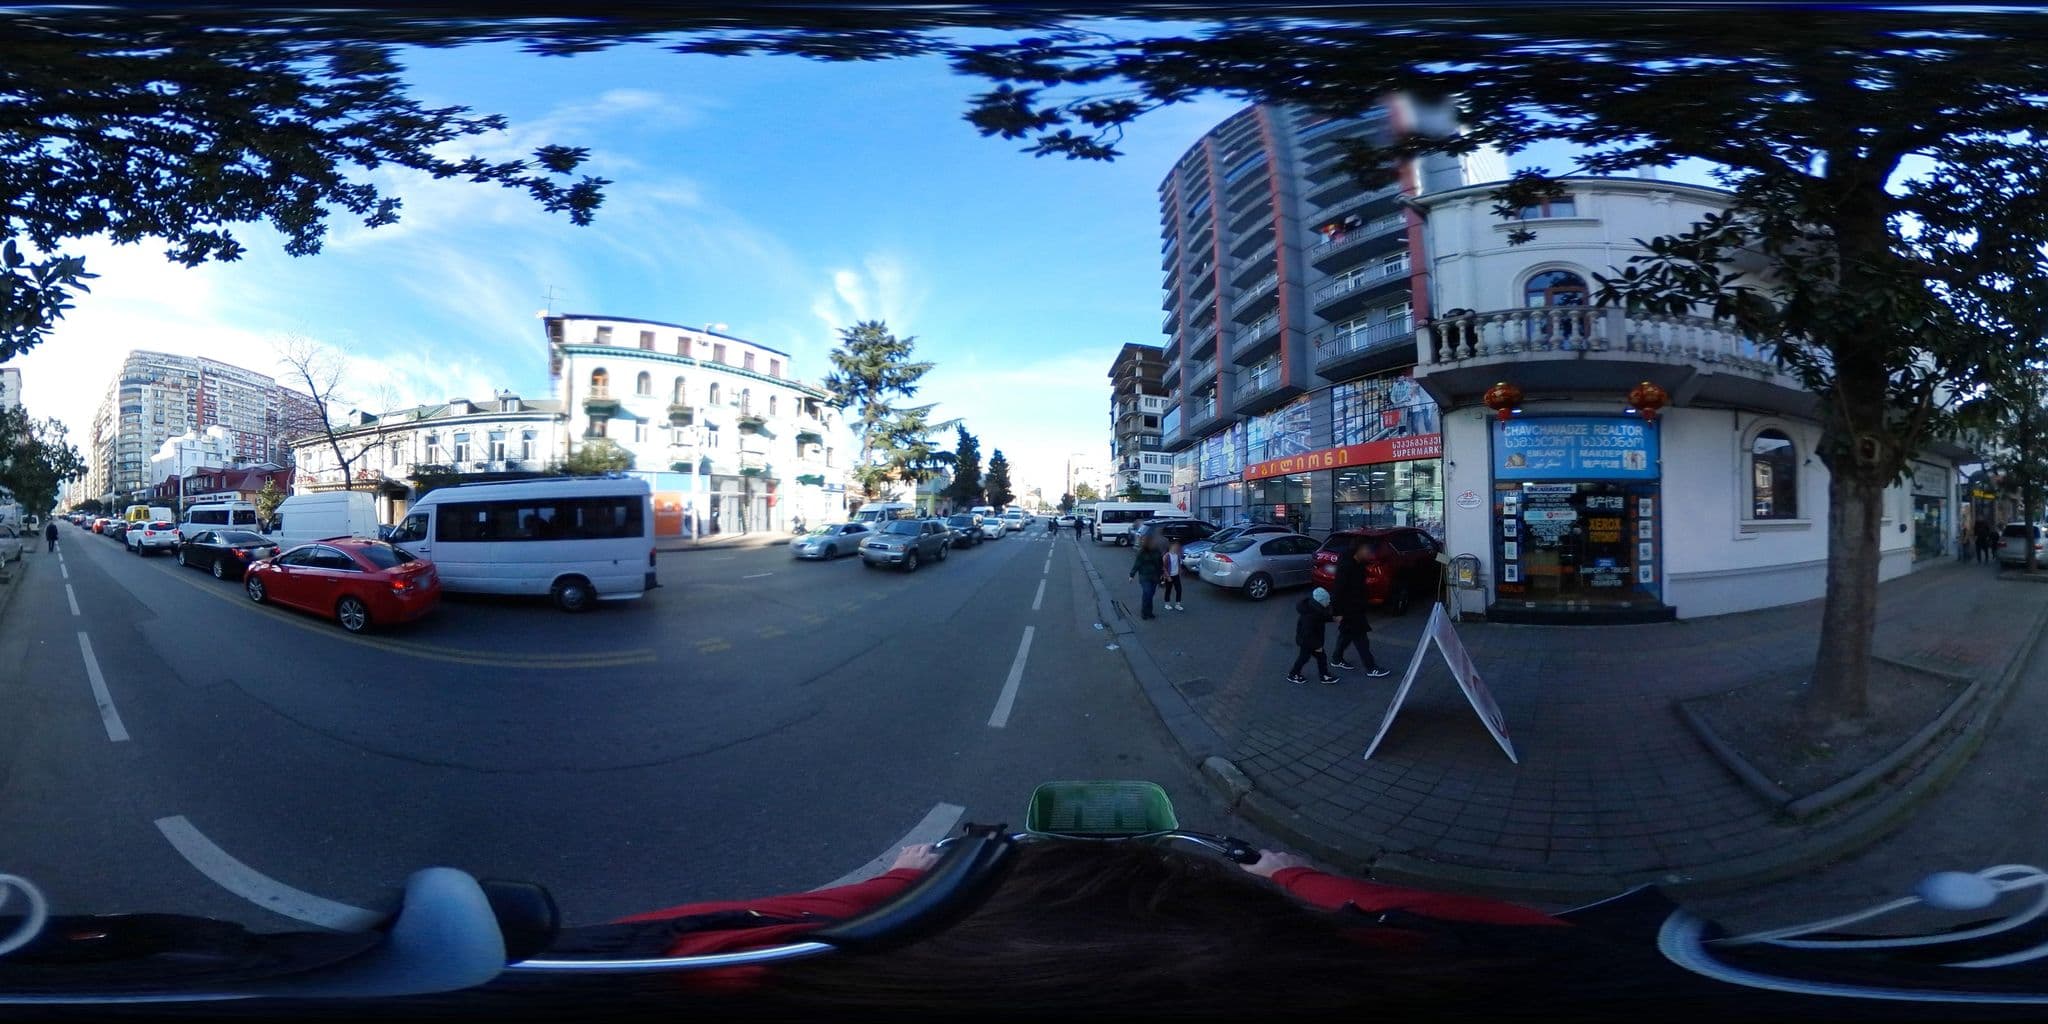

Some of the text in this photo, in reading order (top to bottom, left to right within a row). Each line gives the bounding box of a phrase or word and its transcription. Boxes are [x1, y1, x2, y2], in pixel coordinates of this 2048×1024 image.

[1504, 424, 1644, 437] CHAVCHAVADZE REALTOR
[1588, 518, 1621, 531] XEROX
